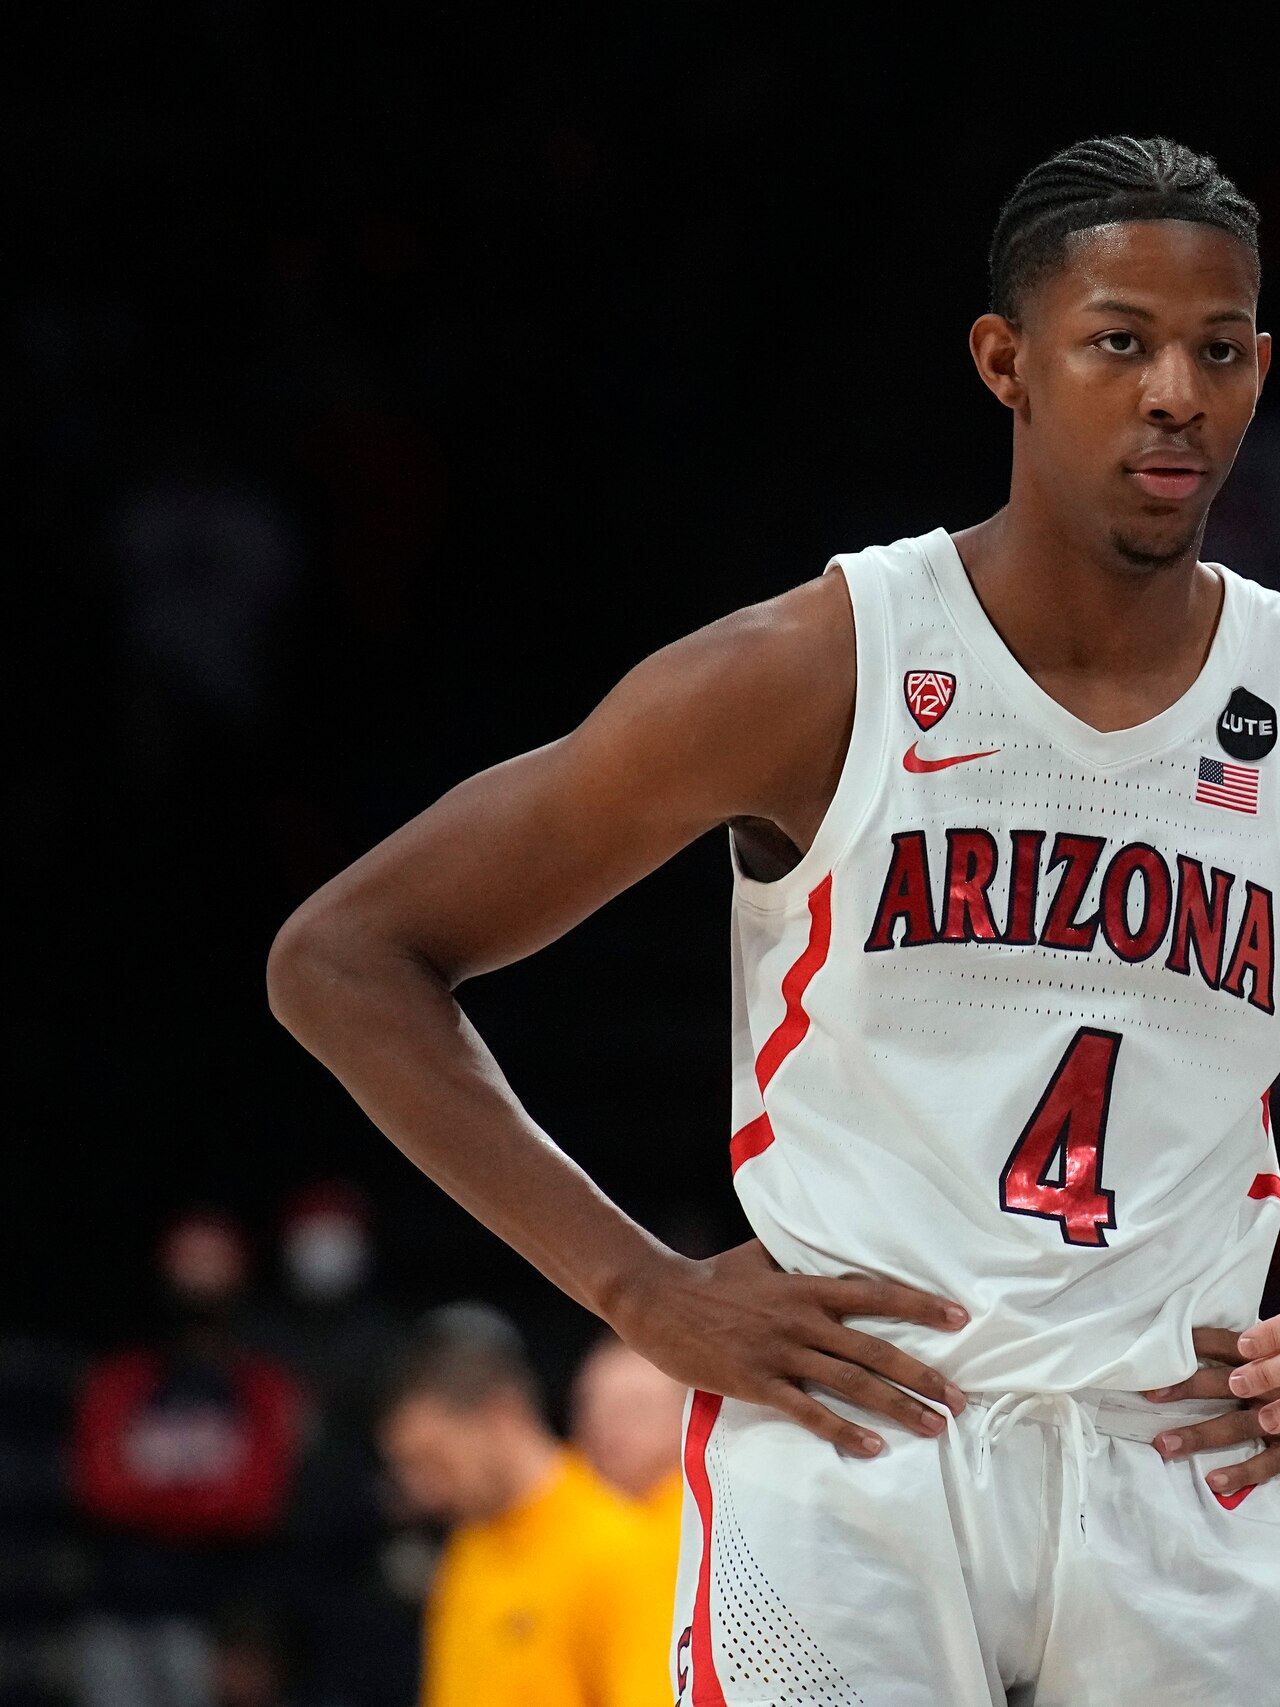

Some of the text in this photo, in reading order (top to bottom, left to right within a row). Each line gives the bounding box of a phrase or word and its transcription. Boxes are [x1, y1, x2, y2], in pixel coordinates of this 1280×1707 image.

[907, 673, 953, 706] PAC
[915, 695, 940, 717] 12
[1222, 710, 1273, 736] LUTE
[864, 828, 1275, 1015] ARIZONA
[1000, 1026, 1122, 1247] 4
